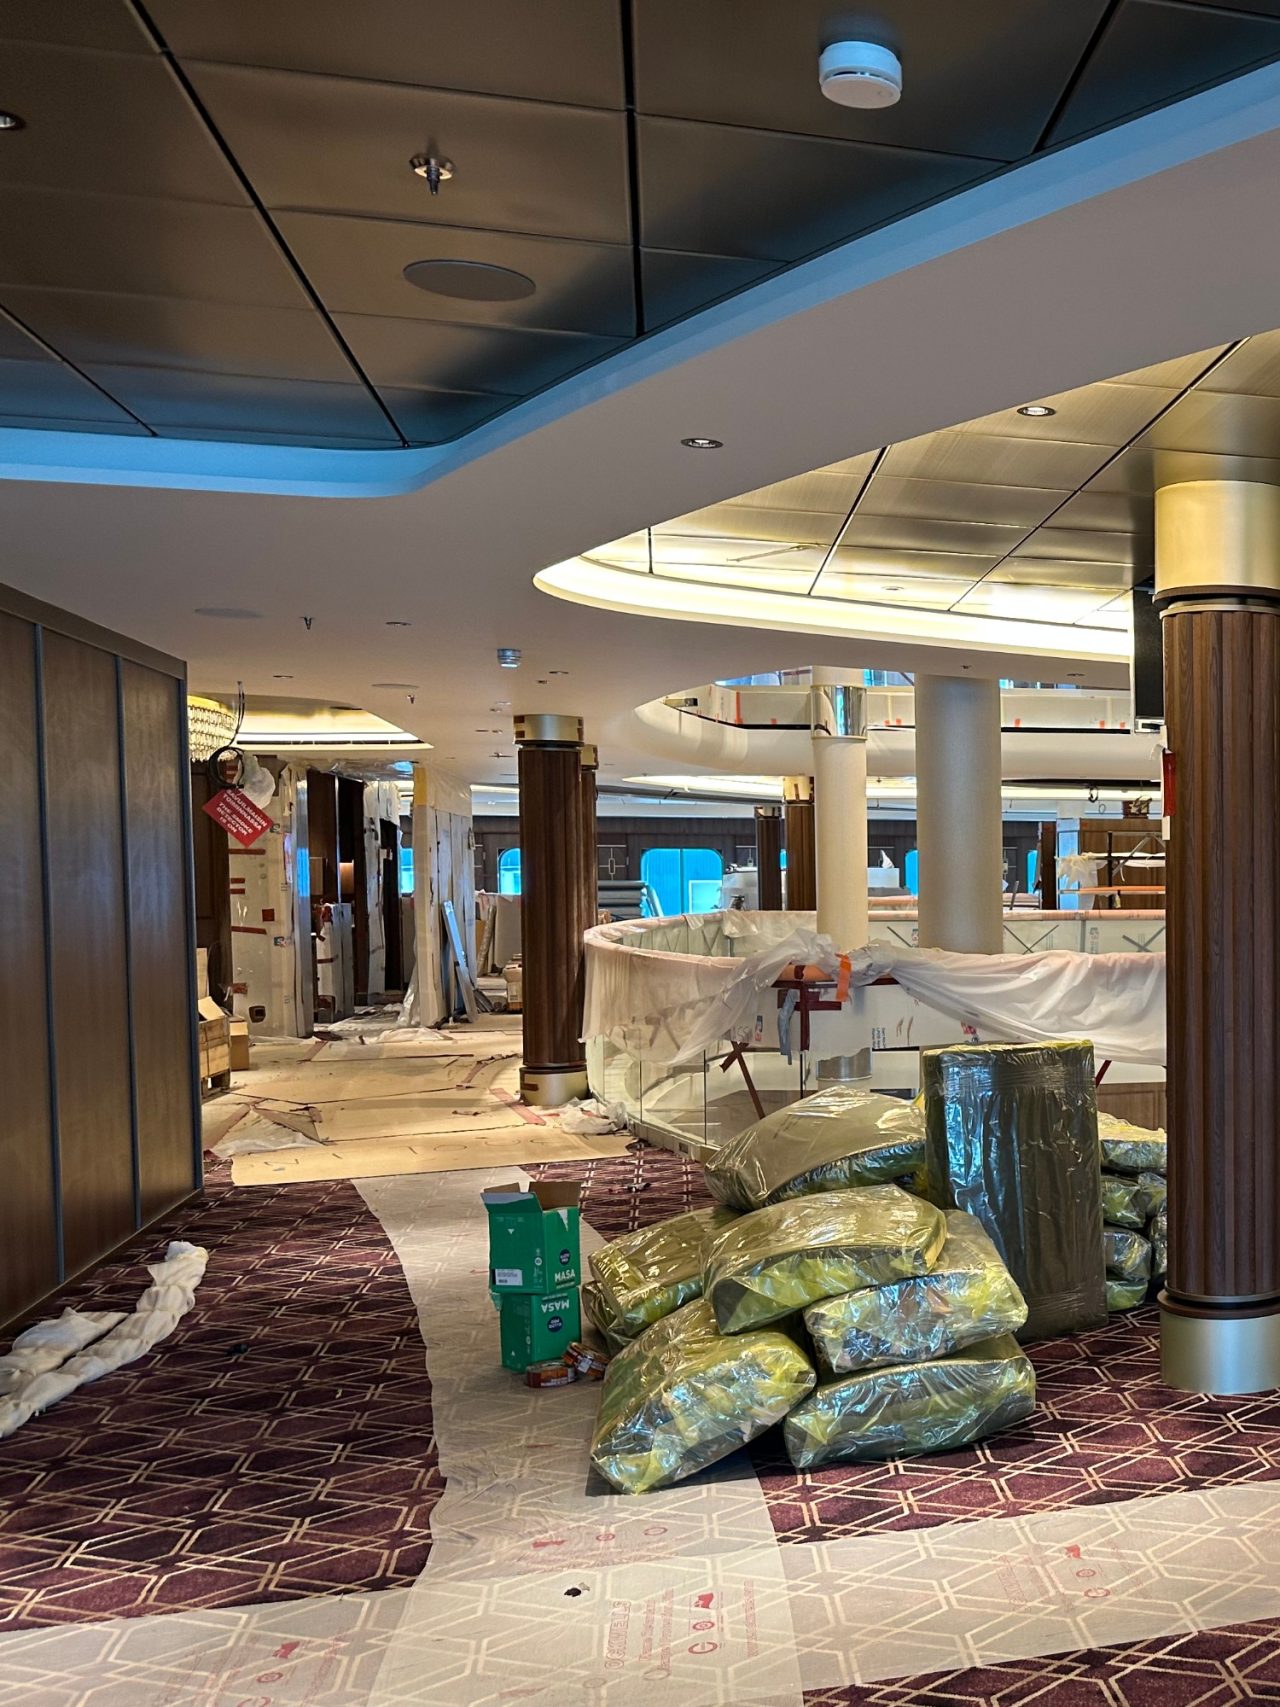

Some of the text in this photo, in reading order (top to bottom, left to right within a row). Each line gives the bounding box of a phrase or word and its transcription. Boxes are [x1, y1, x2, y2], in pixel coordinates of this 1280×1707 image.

[216, 806, 248, 836] DETECTOR
[218, 802, 253, 834] THE SMOKE
[227, 823, 238, 833] ON
[554, 1269, 576, 1282] MASA
[541, 1300, 570, 1313] MASA
